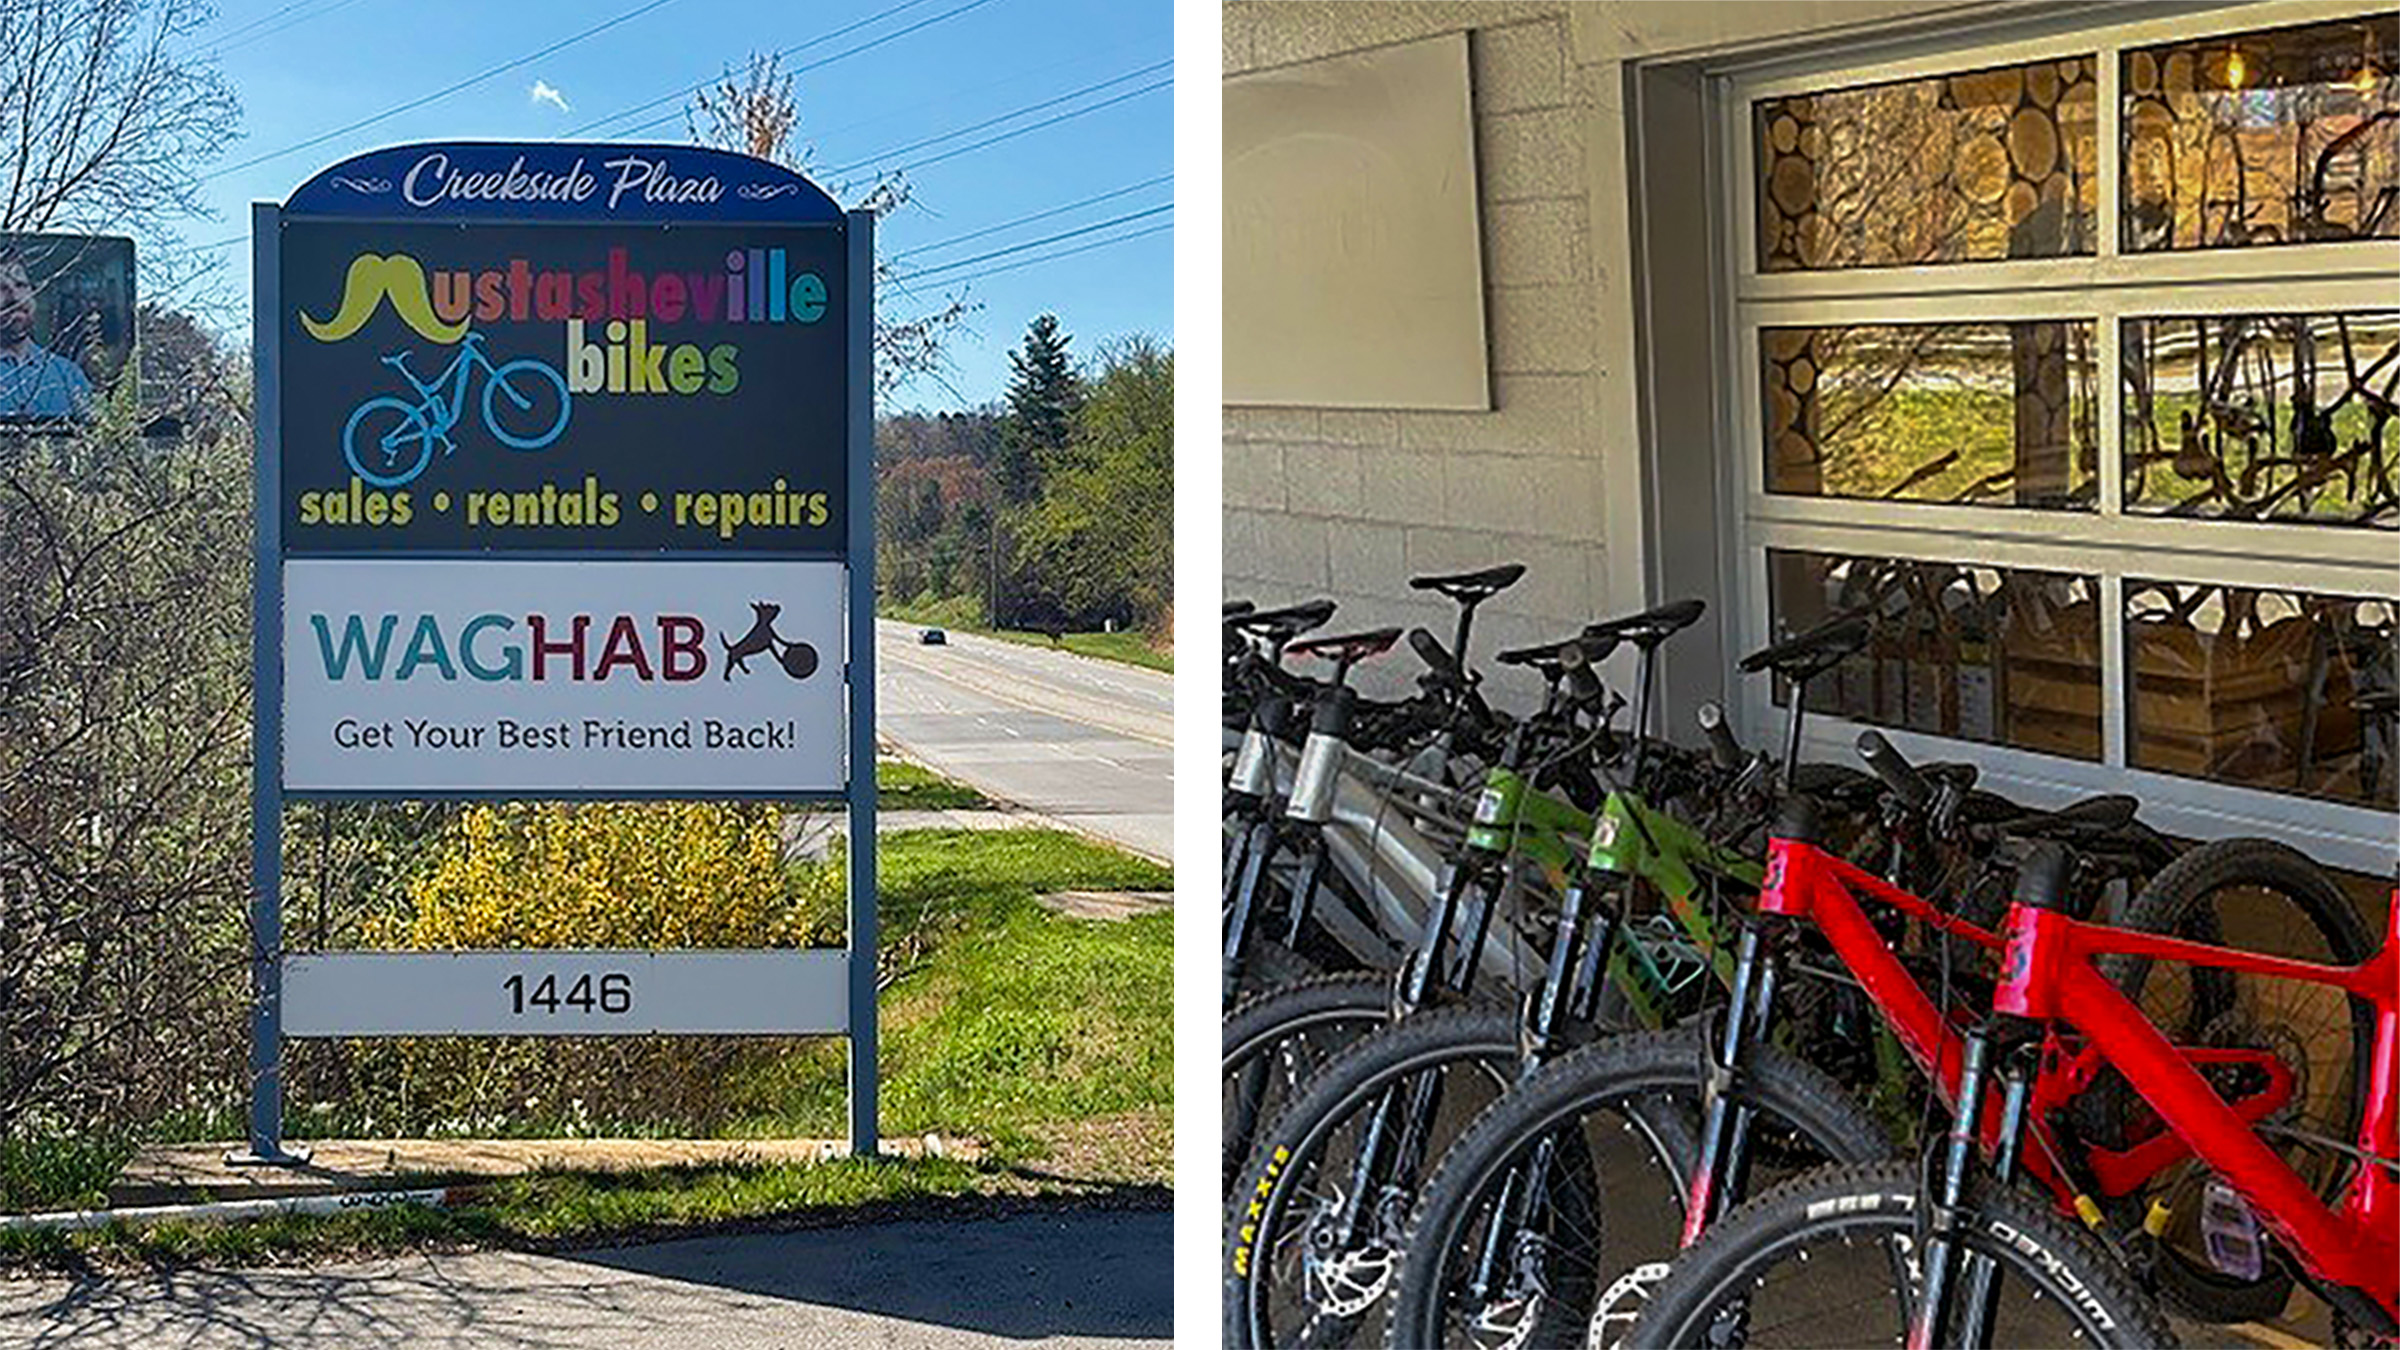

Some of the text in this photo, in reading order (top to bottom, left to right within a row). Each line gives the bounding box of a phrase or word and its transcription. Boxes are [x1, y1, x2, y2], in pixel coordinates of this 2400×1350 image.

[403, 154, 725, 208] Creekside Plaza
[566, 318, 740, 395] bikes
[300, 477, 829, 538] sales rentals repairs
[310, 614, 709, 681] WAGHAB
[334, 720, 796, 750] Get Your Best Friend Back!
[503, 974, 632, 1014] 1446
[1233, 1144, 1290, 1277] MAXXIS
